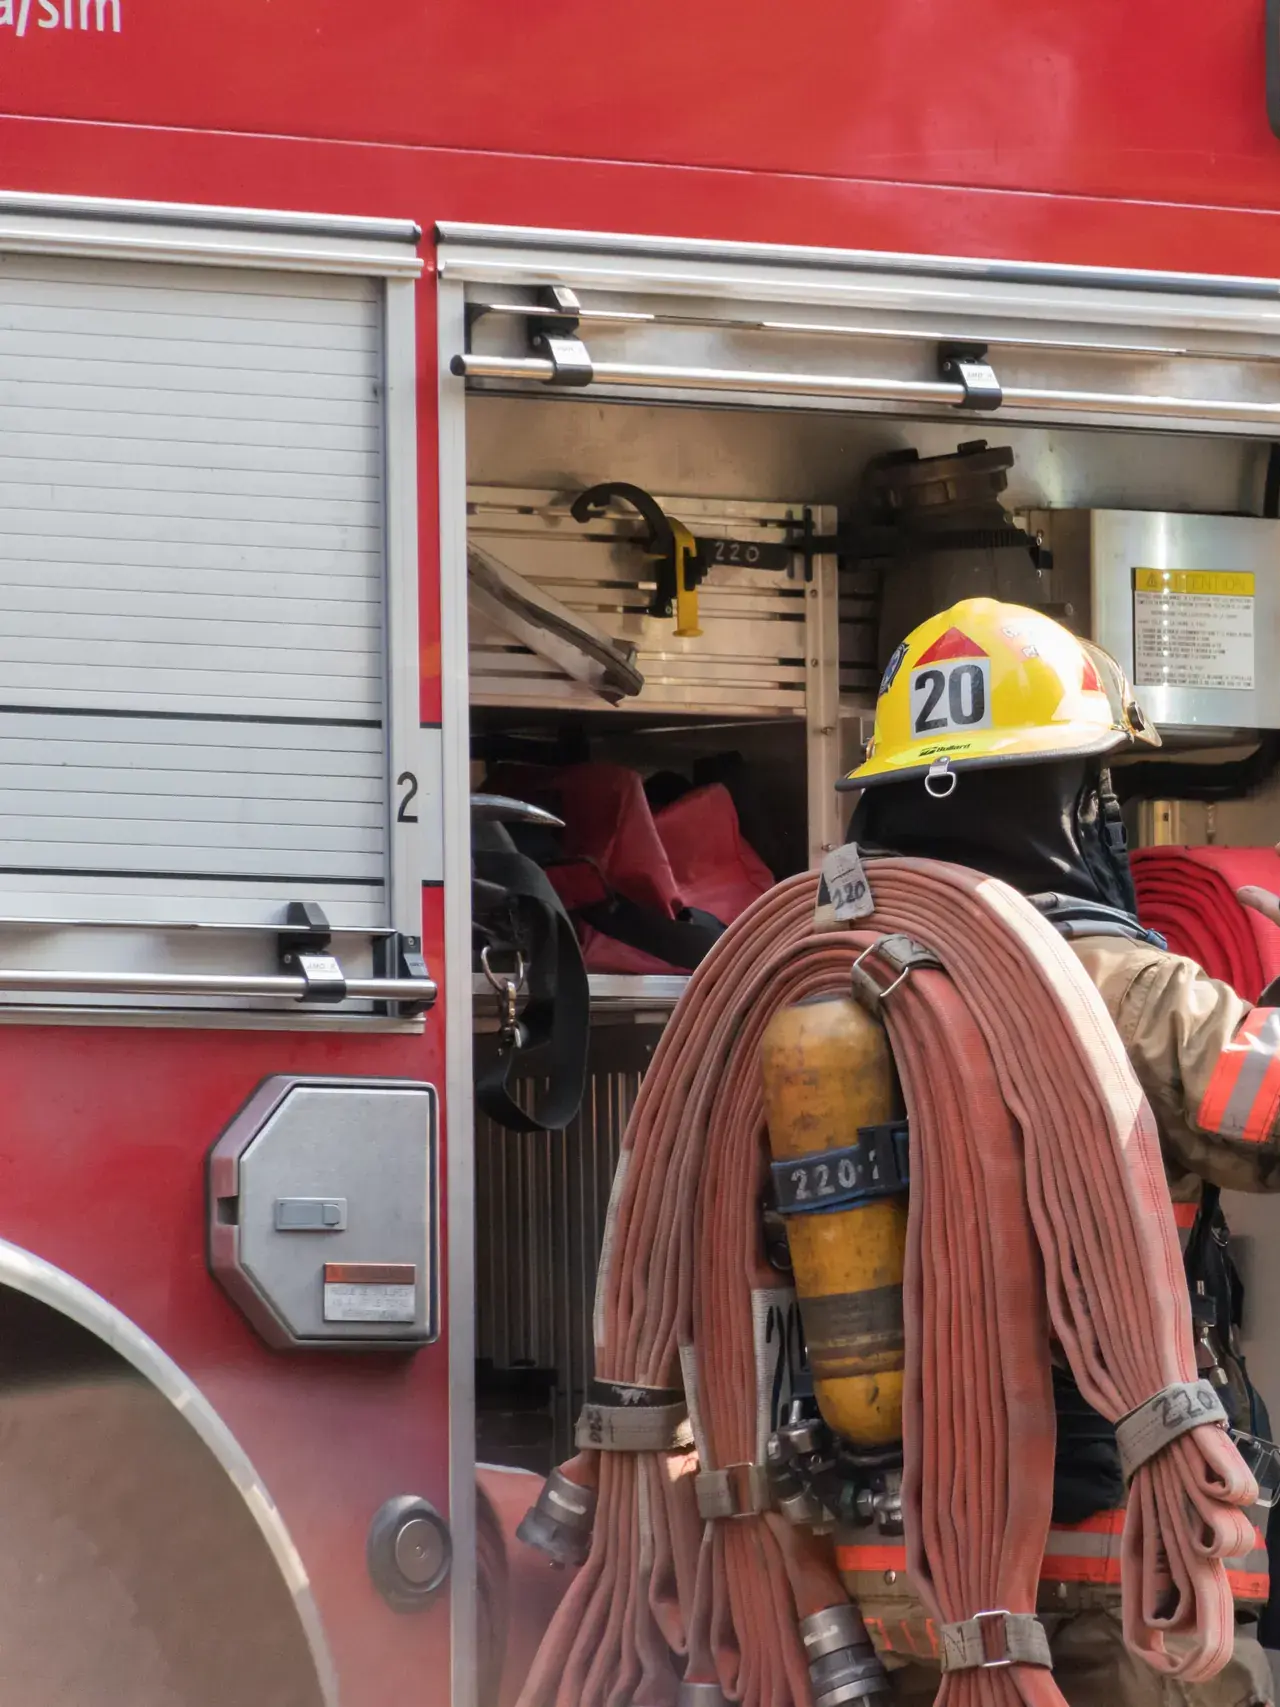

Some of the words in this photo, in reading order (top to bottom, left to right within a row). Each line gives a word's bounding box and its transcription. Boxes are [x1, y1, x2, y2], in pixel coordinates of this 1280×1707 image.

[714, 541, 760, 562] 220
[914, 664, 985, 734] 20
[397, 771, 418, 823] 2
[832, 880, 866, 911] 220
[1151, 1387, 1215, 1427] 220
